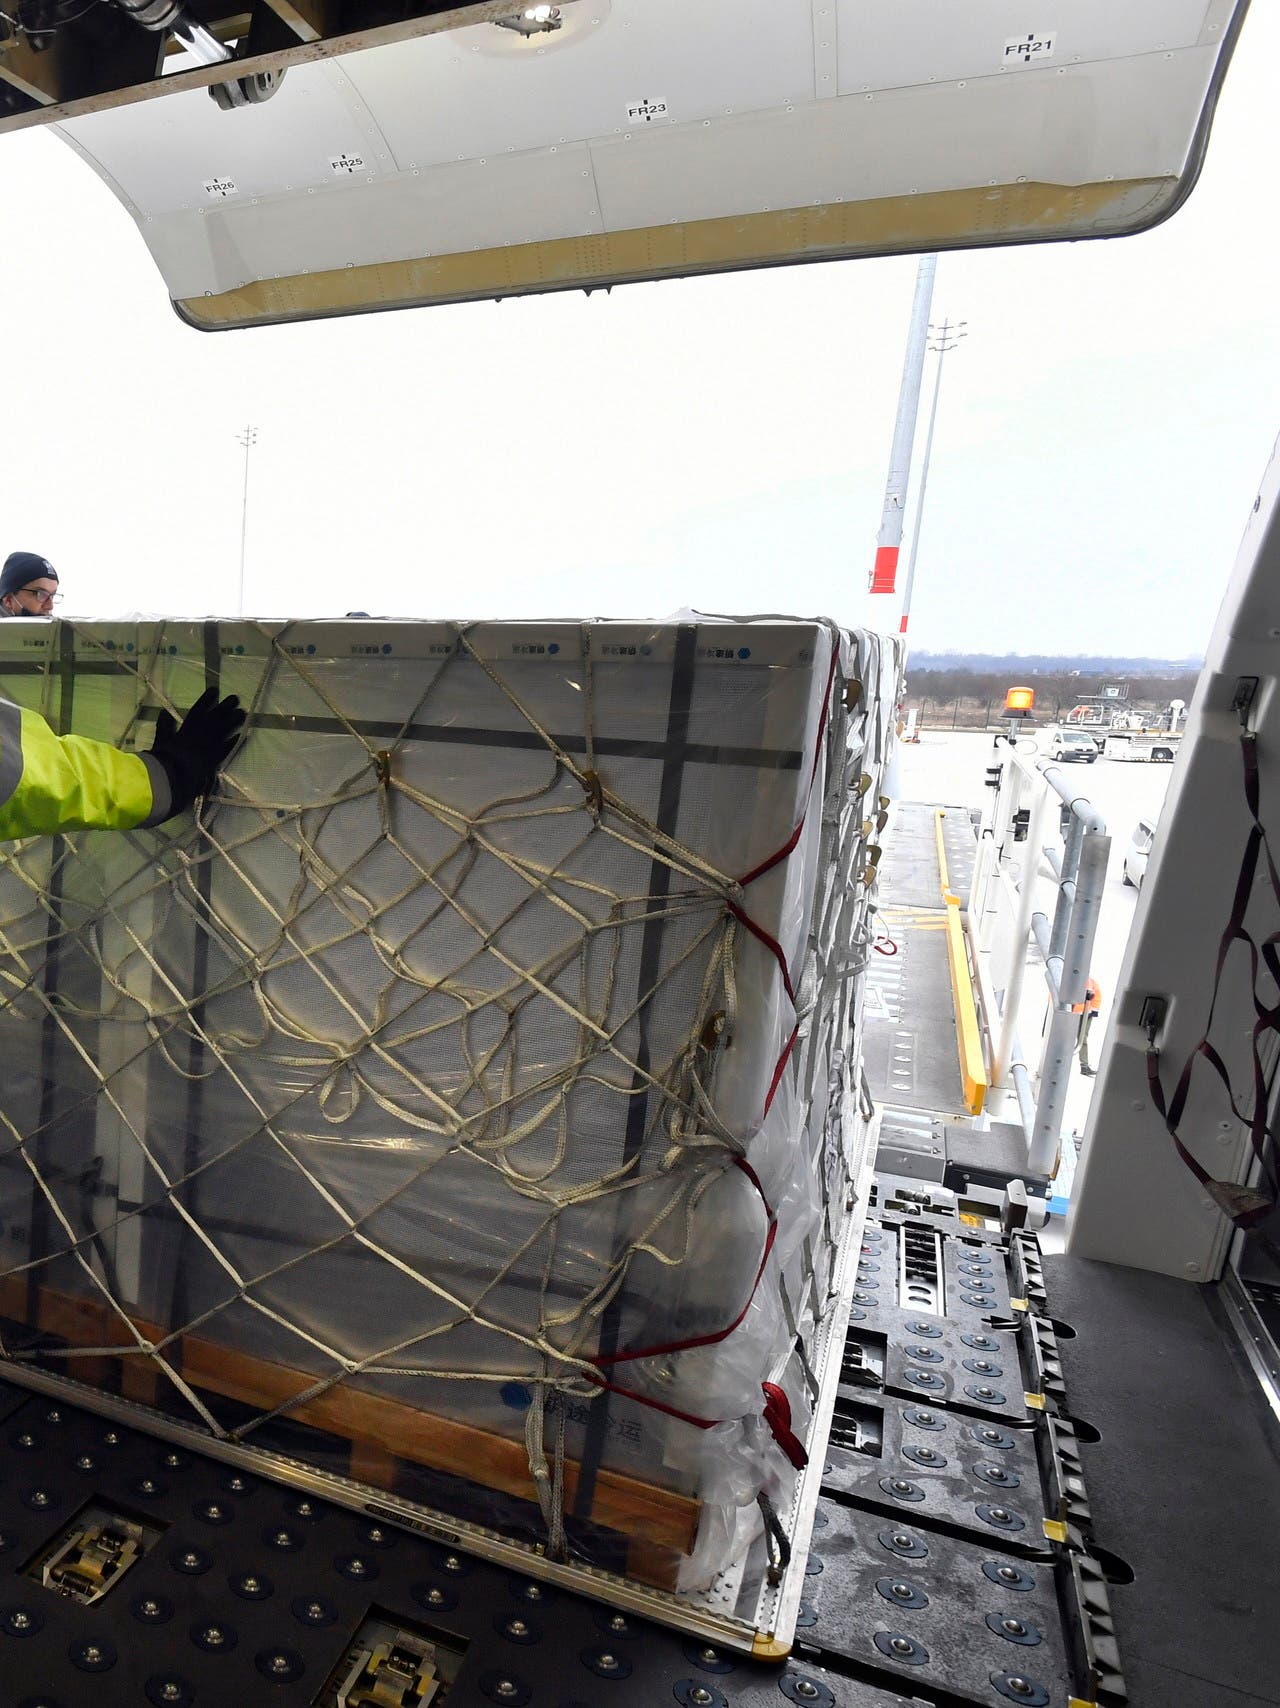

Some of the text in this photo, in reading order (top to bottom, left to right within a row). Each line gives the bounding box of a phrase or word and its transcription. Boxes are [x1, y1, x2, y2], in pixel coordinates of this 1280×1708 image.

[1005, 40, 1051, 55] FR21
[628, 103, 666, 117] FR23
[331, 157, 363, 169] FR25
[205, 181, 235, 193] FR26
